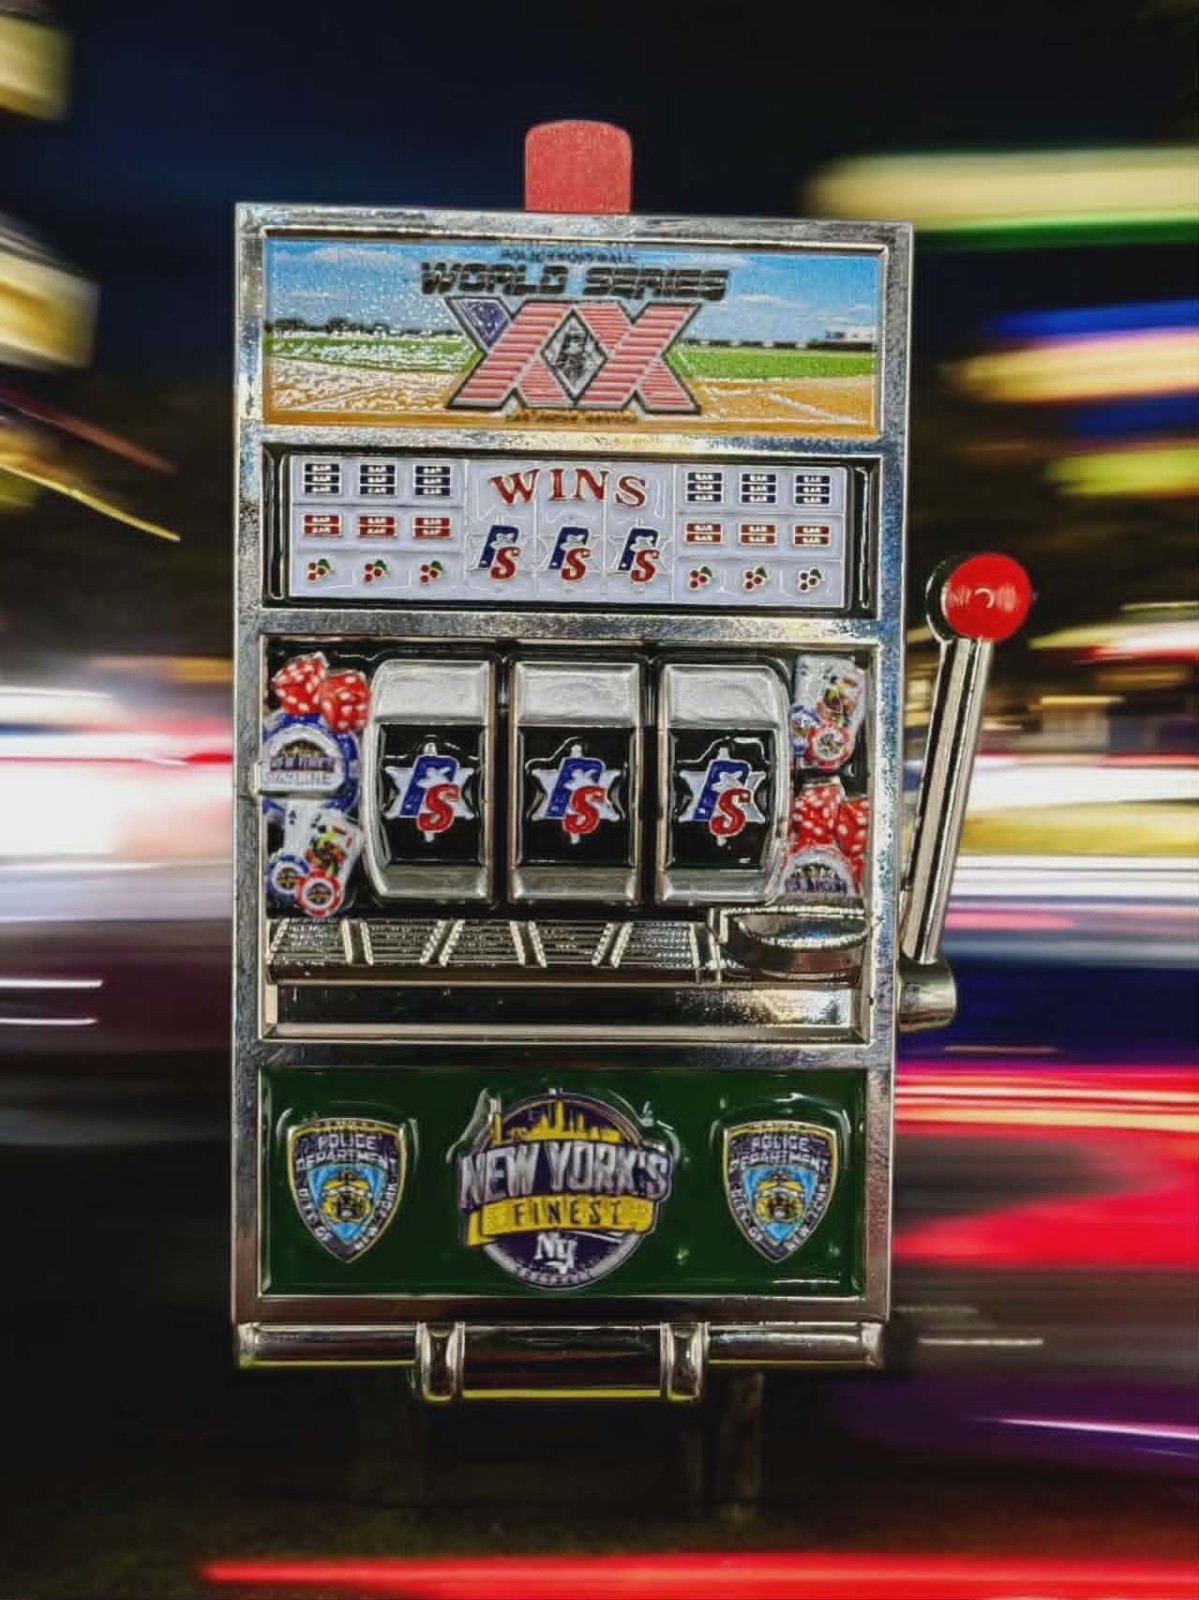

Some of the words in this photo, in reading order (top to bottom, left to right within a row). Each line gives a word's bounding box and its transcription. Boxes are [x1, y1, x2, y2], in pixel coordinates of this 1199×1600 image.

[421, 262, 568, 295] WORLD
[583, 268, 729, 300] SERIES
[489, 468, 646, 507] WINS
[318, 1133, 376, 1150] POLICE
[752, 1135, 809, 1151] POLICE
[296, 1149, 397, 1171] DEPARTMENT
[458, 1142, 539, 1211] NEW
[545, 1141, 672, 1200] YORK'S
[514, 1201, 623, 1227] FINEST
